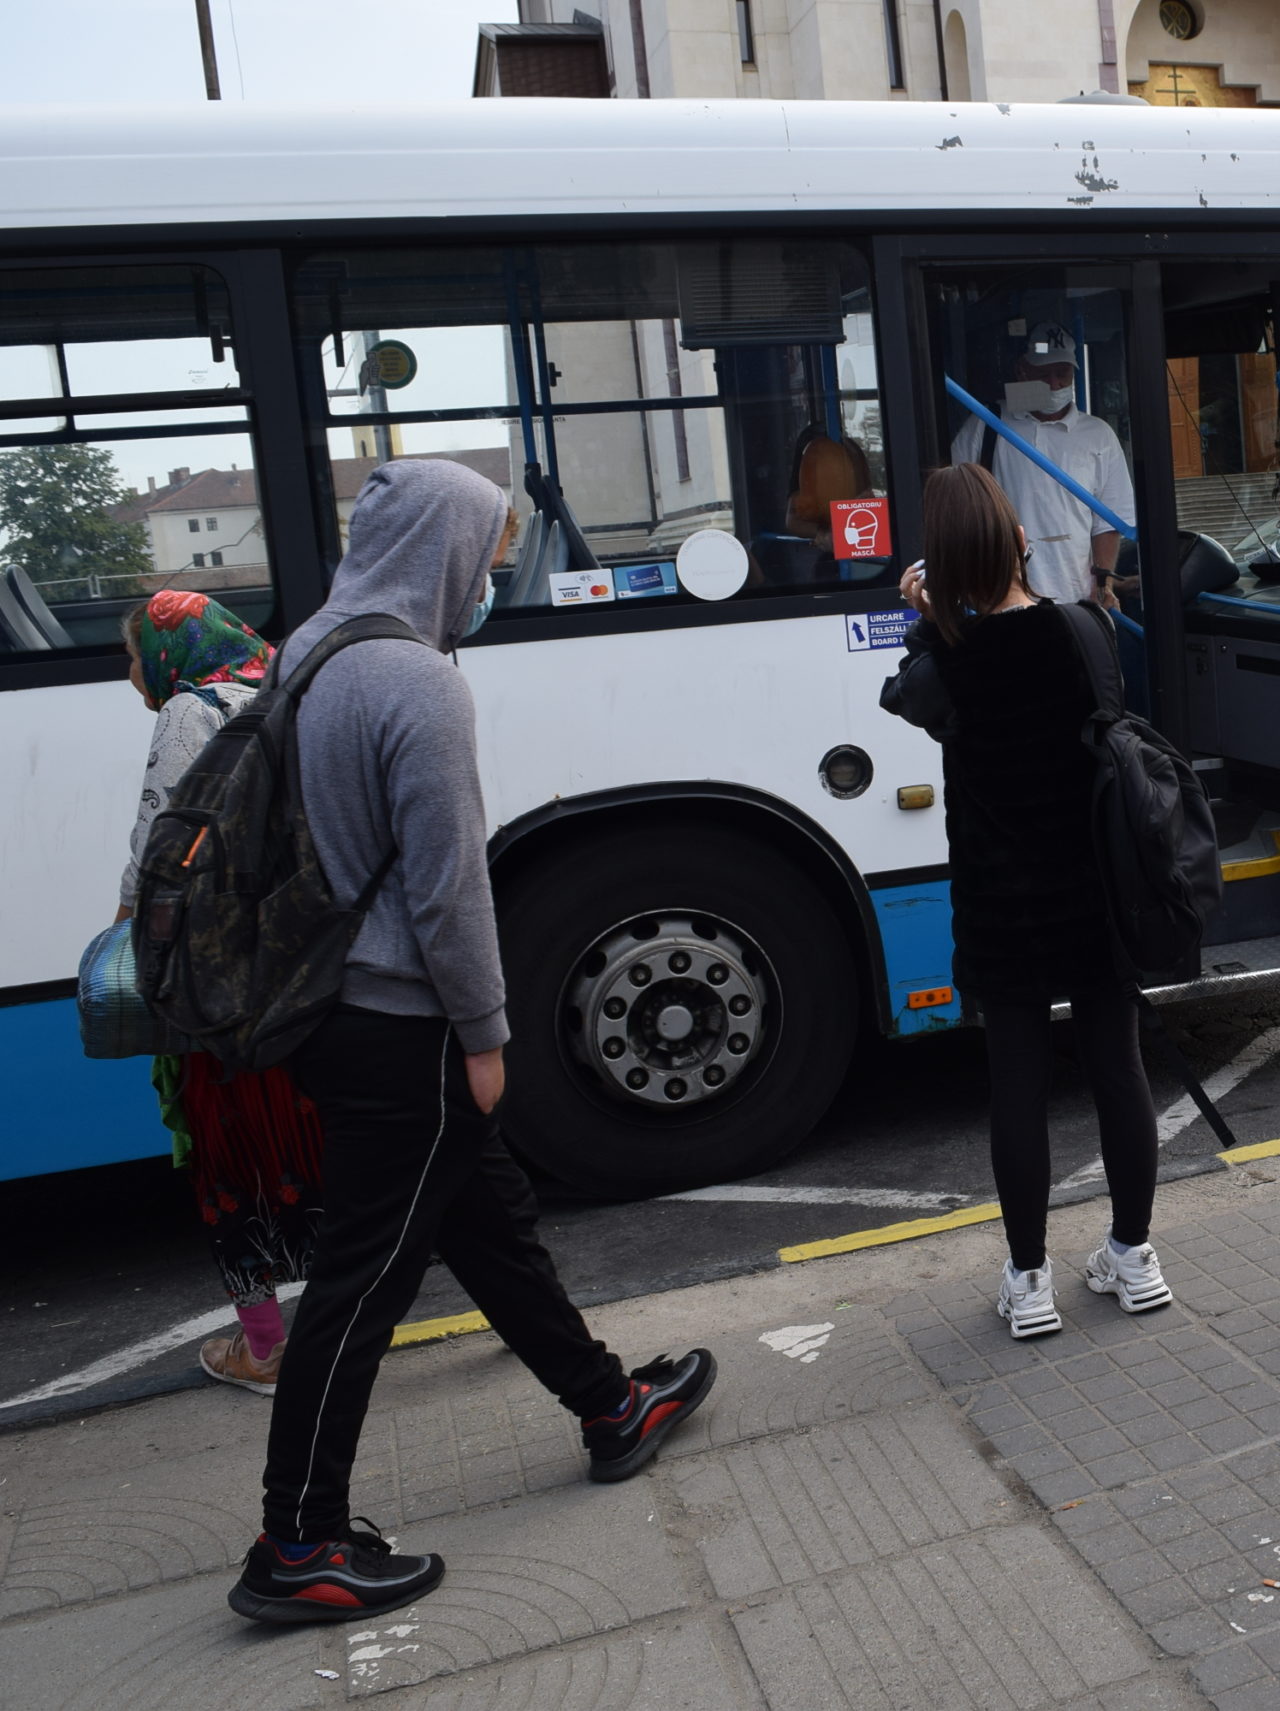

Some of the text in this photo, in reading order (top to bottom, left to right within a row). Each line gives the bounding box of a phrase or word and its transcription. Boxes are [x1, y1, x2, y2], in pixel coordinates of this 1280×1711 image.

[837, 501, 882, 510] OBLIGATORIU
[561, 590, 579, 598] VISA
[869, 612, 905, 623] URCARE
[871, 636, 899, 646] BOARD
